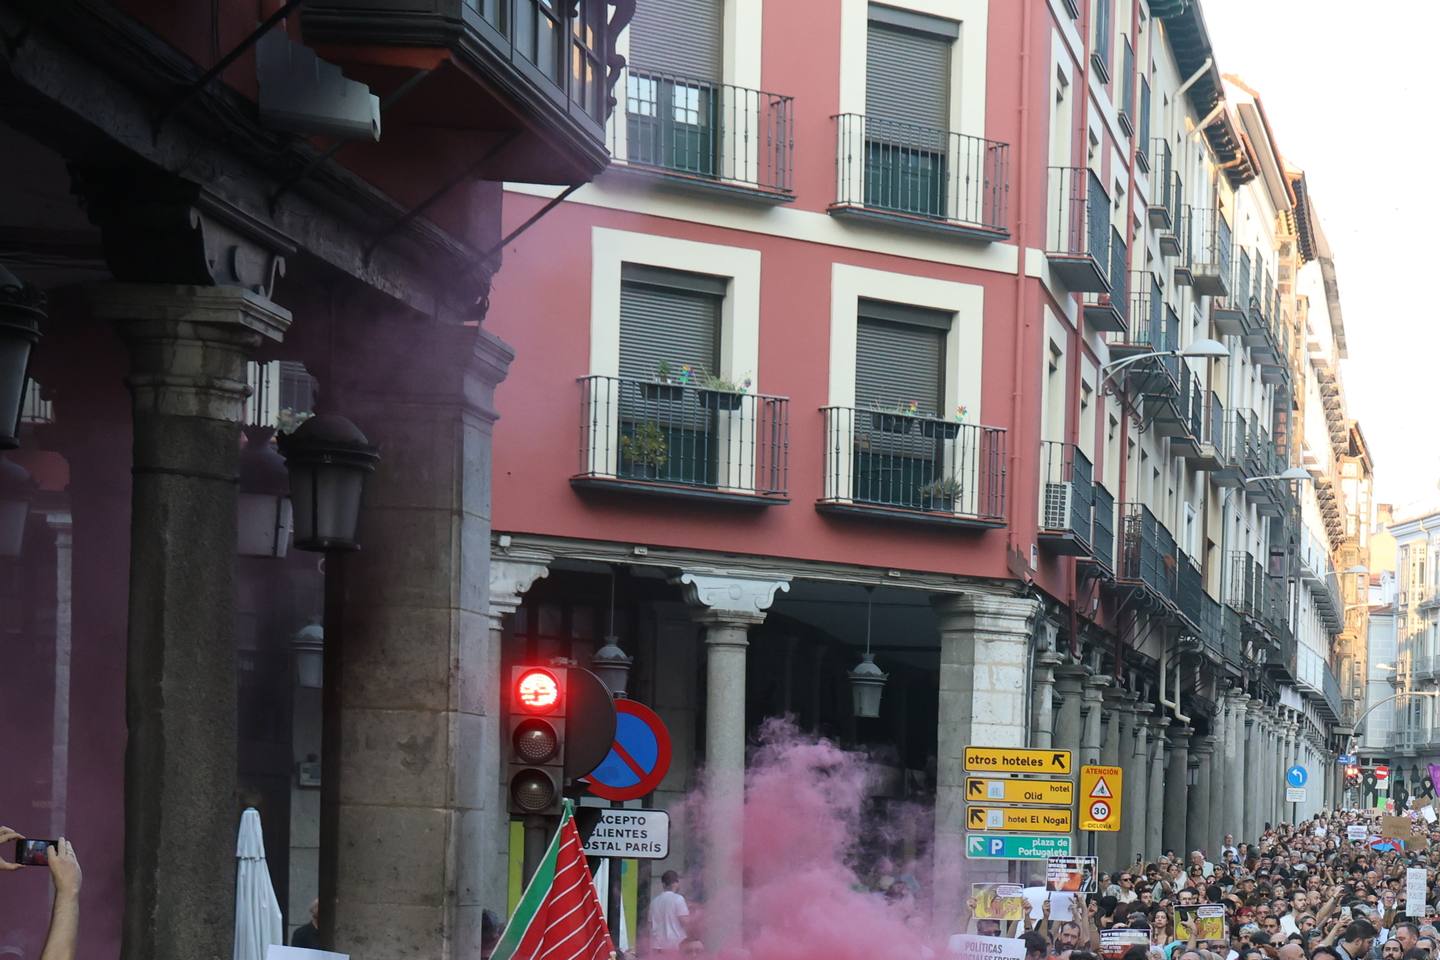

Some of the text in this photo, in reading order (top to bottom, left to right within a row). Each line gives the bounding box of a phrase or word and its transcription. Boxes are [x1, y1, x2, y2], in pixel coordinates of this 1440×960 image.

[968, 753, 1043, 767] otros hoteles
[1024, 791, 1043, 800] Olid
[1094, 807, 1107, 815] 30
[601, 815, 646, 826] XCEPTO
[1008, 814, 1068, 826] hotel El Nogal
[584, 841, 661, 853] OSTAL PARÍS
[991, 840, 1003, 854] P
[1032, 838, 1068, 847] plaza de
[1018, 847, 1068, 857] Portugalete
